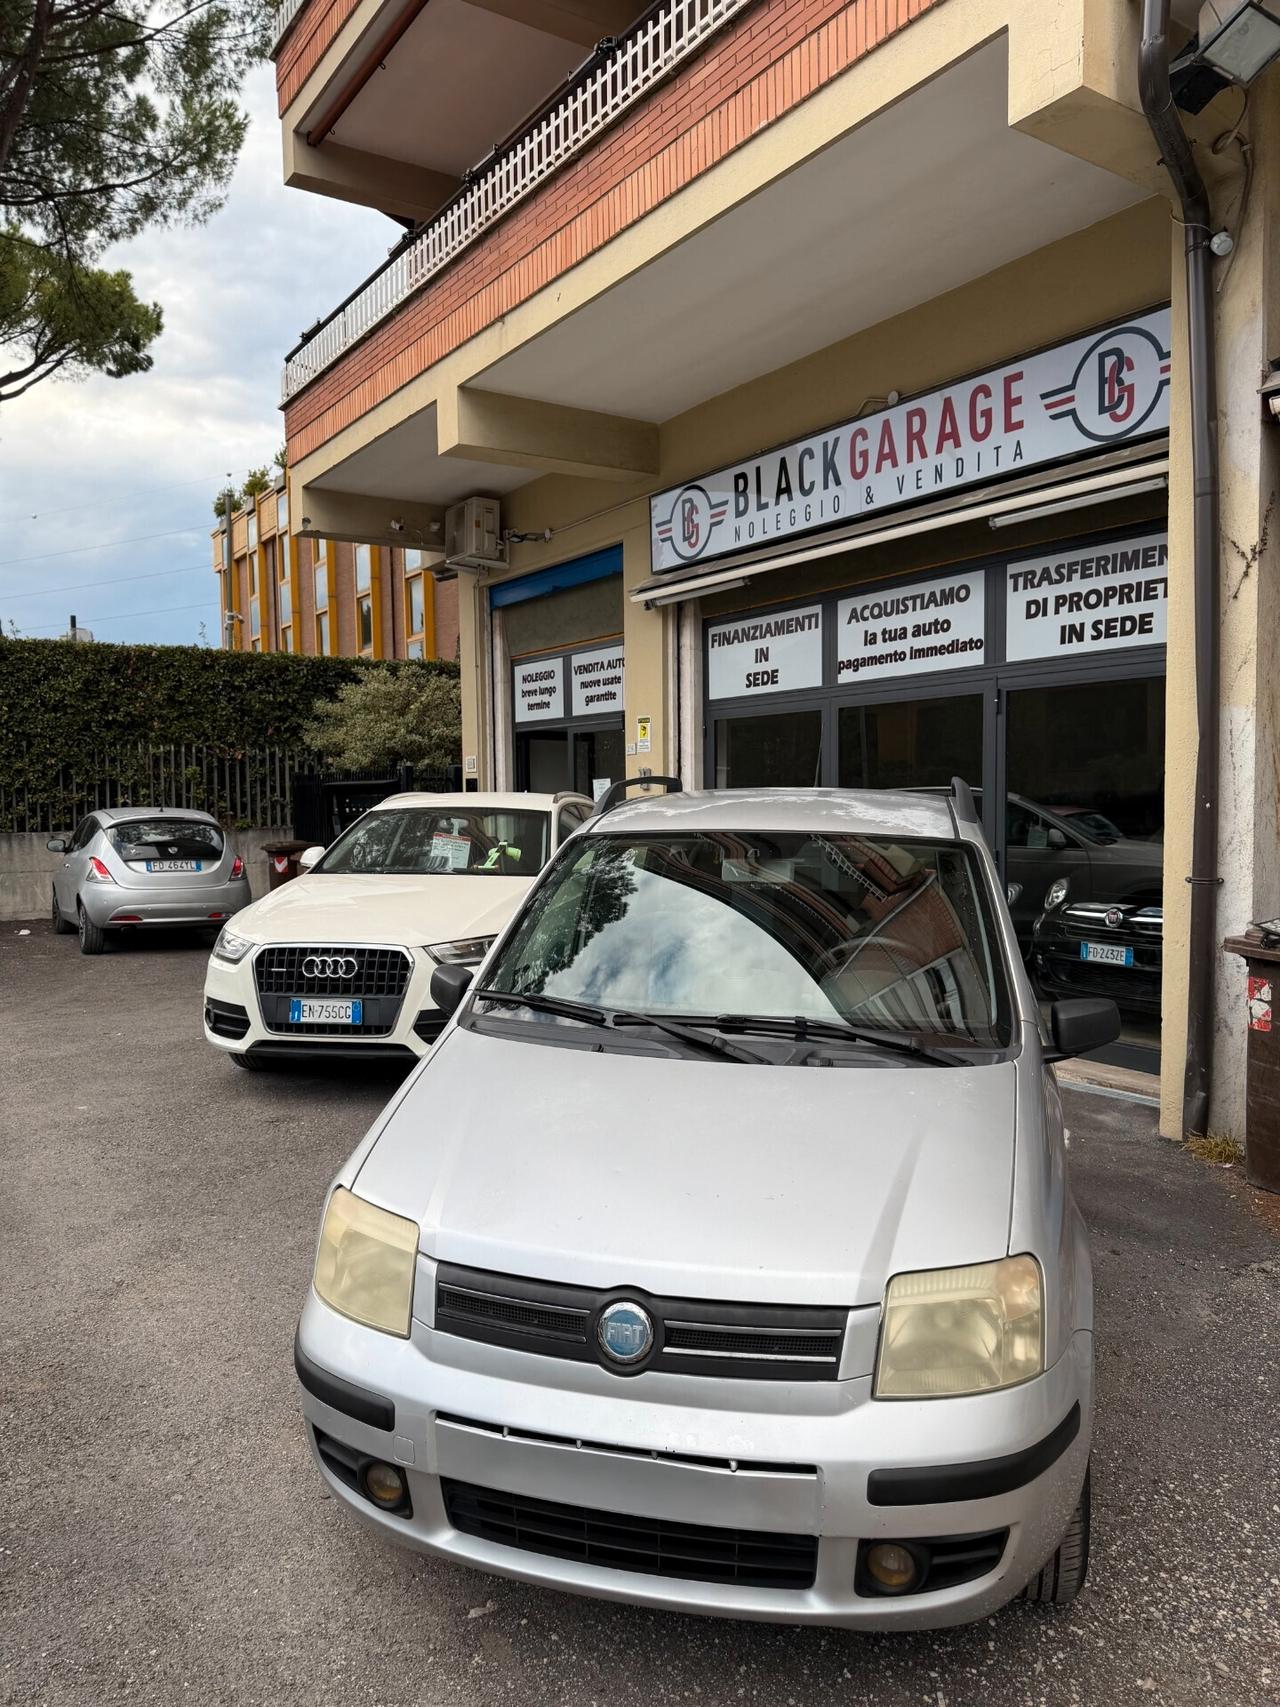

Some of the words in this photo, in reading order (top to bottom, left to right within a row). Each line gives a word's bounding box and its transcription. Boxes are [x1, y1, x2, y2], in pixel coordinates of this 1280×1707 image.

[734, 495, 840, 543] NOLEGGIO
[865, 485, 874, 505] &
[897, 440, 1023, 495] VENDITA
[846, 584, 971, 625] ACQUISTIAMO
[1025, 597, 1048, 620] DI
[711, 612, 820, 649] FINANZIAMENTI
[863, 630, 877, 646] la
[881, 626, 907, 643] tua
[911, 618, 951, 638] auto
[1059, 622, 1085, 645] IN
[1090, 612, 1154, 641] SEDE
[754, 646, 769, 664] IN
[837, 650, 907, 674] pagamento
[909, 636, 984, 661] immediato
[522, 670, 556, 684] NOLEGGIO
[573, 661, 606, 676] VENDITA
[745, 669, 779, 689] SEDE
[521, 688, 538, 698] breve
[538, 685, 557, 697] lungo
[580, 679, 601, 689] nuove
[602, 675, 622, 686] usate
[527, 700, 551, 711] termine
[585, 690, 617, 706] garantite
[607, 1321, 644, 1345] FIAT
